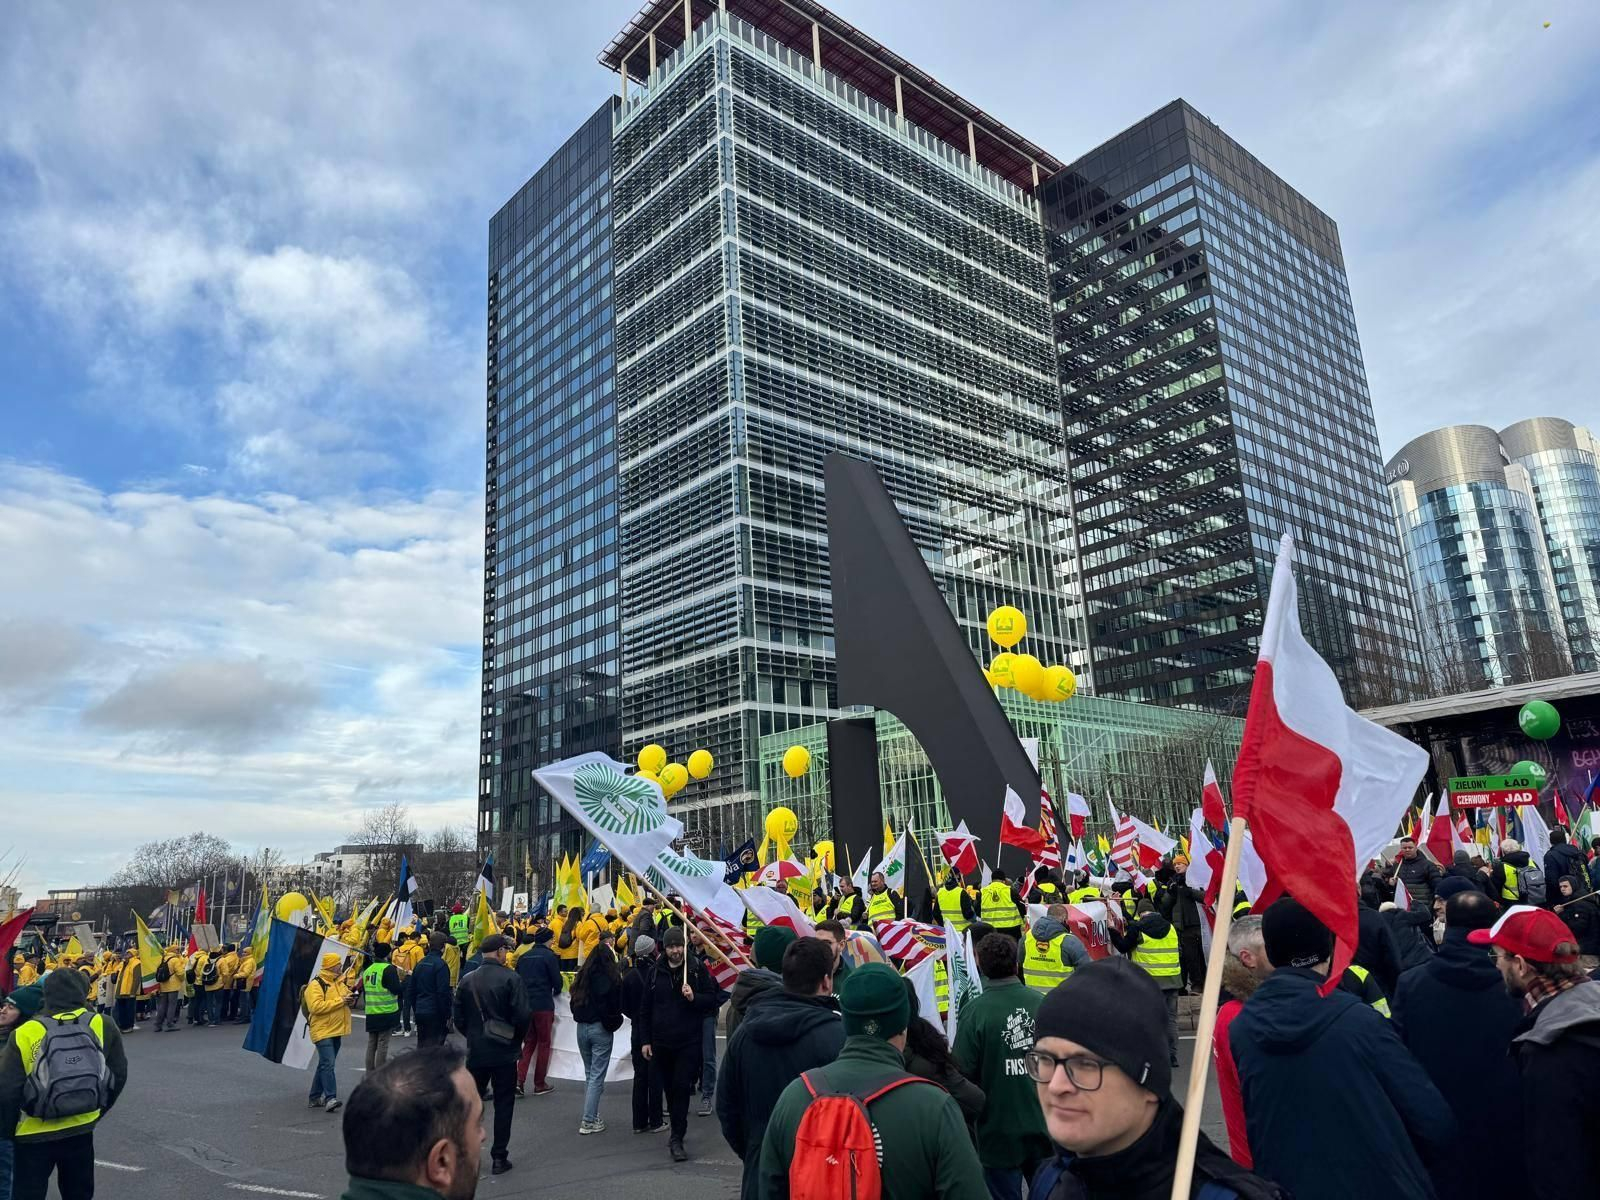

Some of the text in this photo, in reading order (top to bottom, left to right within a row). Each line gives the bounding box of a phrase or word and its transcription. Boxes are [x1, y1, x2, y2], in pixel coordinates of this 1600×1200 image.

[1455, 778, 1530, 790] ZIELONY ŁAD
[1457, 792, 1533, 805] CZERWONY JAD
[1007, 1014, 1023, 1030] NATURE
